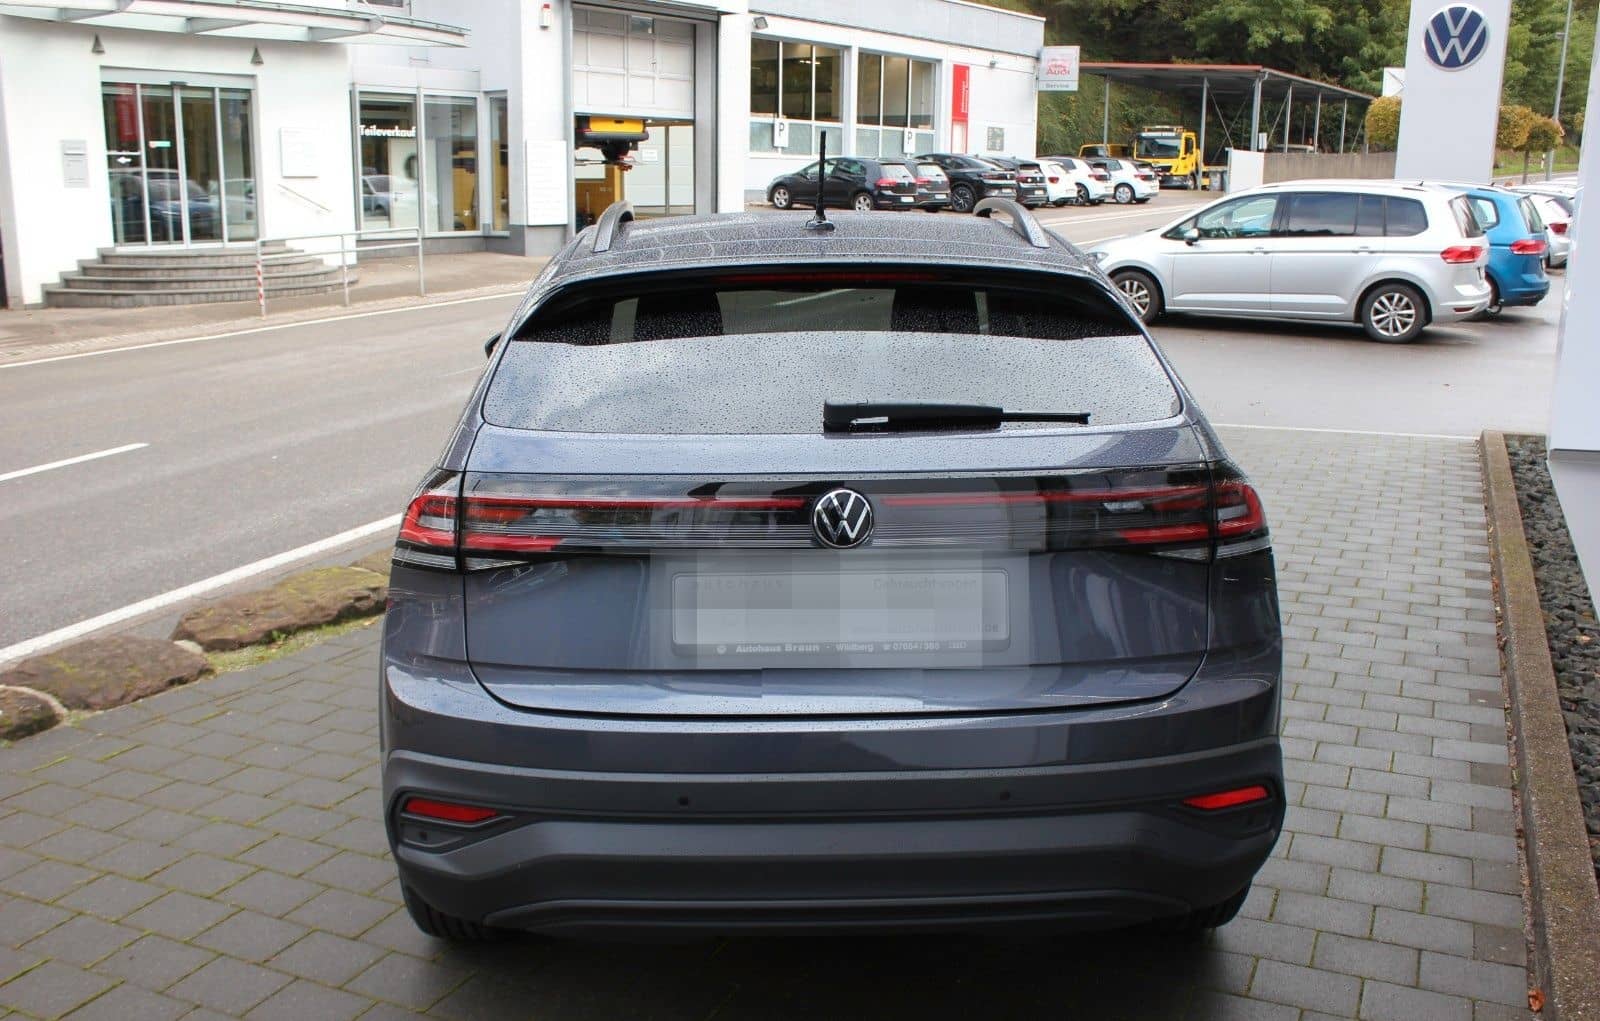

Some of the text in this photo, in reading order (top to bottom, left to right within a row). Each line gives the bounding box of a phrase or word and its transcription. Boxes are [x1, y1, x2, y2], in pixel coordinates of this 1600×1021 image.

[1425, 6, 1487, 67] VW
[1046, 66, 1071, 75] Audi
[358, 124, 416, 137] Teileverkauf
[778, 122, 785, 136] P
[907, 131, 913, 145] P
[814, 490, 871, 547] VW
[735, 644, 782, 653] Autohaus
[784, 643, 820, 652] Braun
